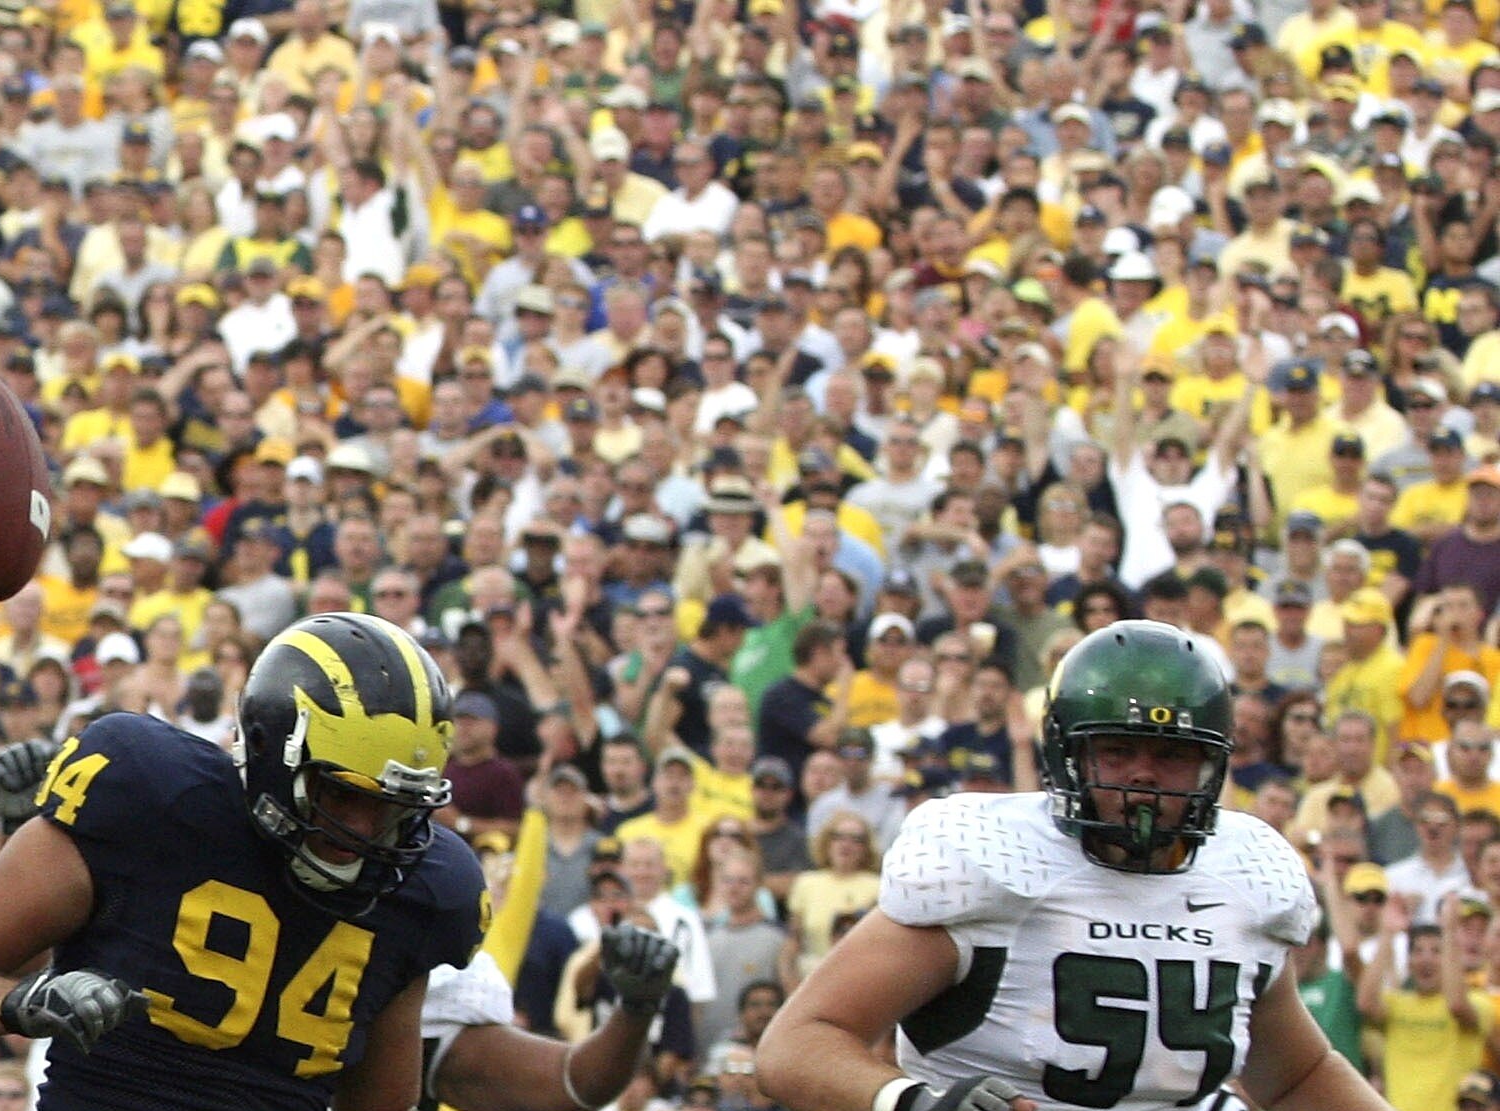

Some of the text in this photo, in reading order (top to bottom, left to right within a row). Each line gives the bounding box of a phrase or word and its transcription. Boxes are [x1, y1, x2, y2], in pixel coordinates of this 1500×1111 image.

[141, 879, 376, 1079] 94
[1089, 922, 1214, 947] DUCKS
[1042, 952, 1240, 1110] 54
